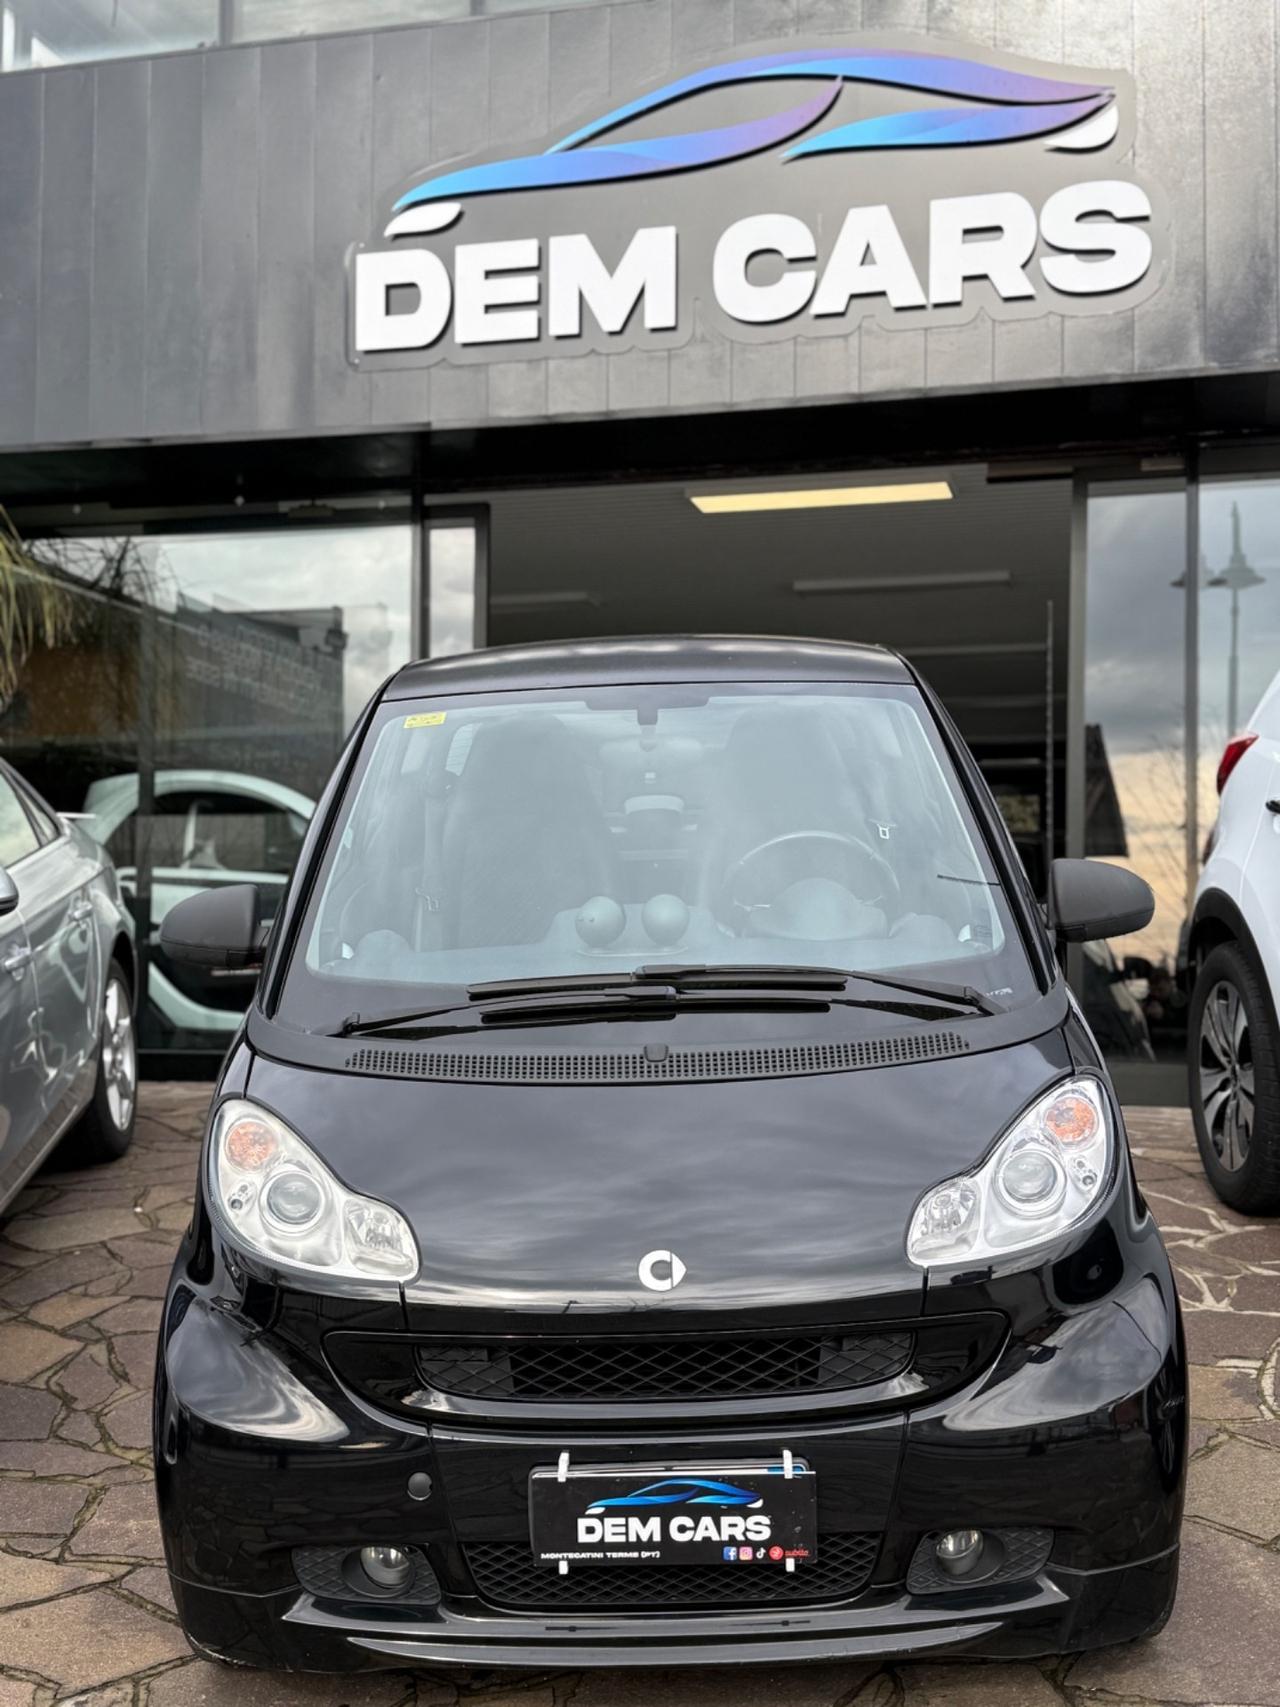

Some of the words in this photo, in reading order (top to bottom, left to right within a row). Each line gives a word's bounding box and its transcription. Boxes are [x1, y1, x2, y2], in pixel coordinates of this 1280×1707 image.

[355, 226, 677, 352] DEM
[712, 180, 1152, 323] CARS
[577, 1516, 661, 1543] DEM
[669, 1515, 772, 1542] CARS
[540, 1552, 604, 1560] MONTECATINI
[605, 1551, 639, 1559] TERME
